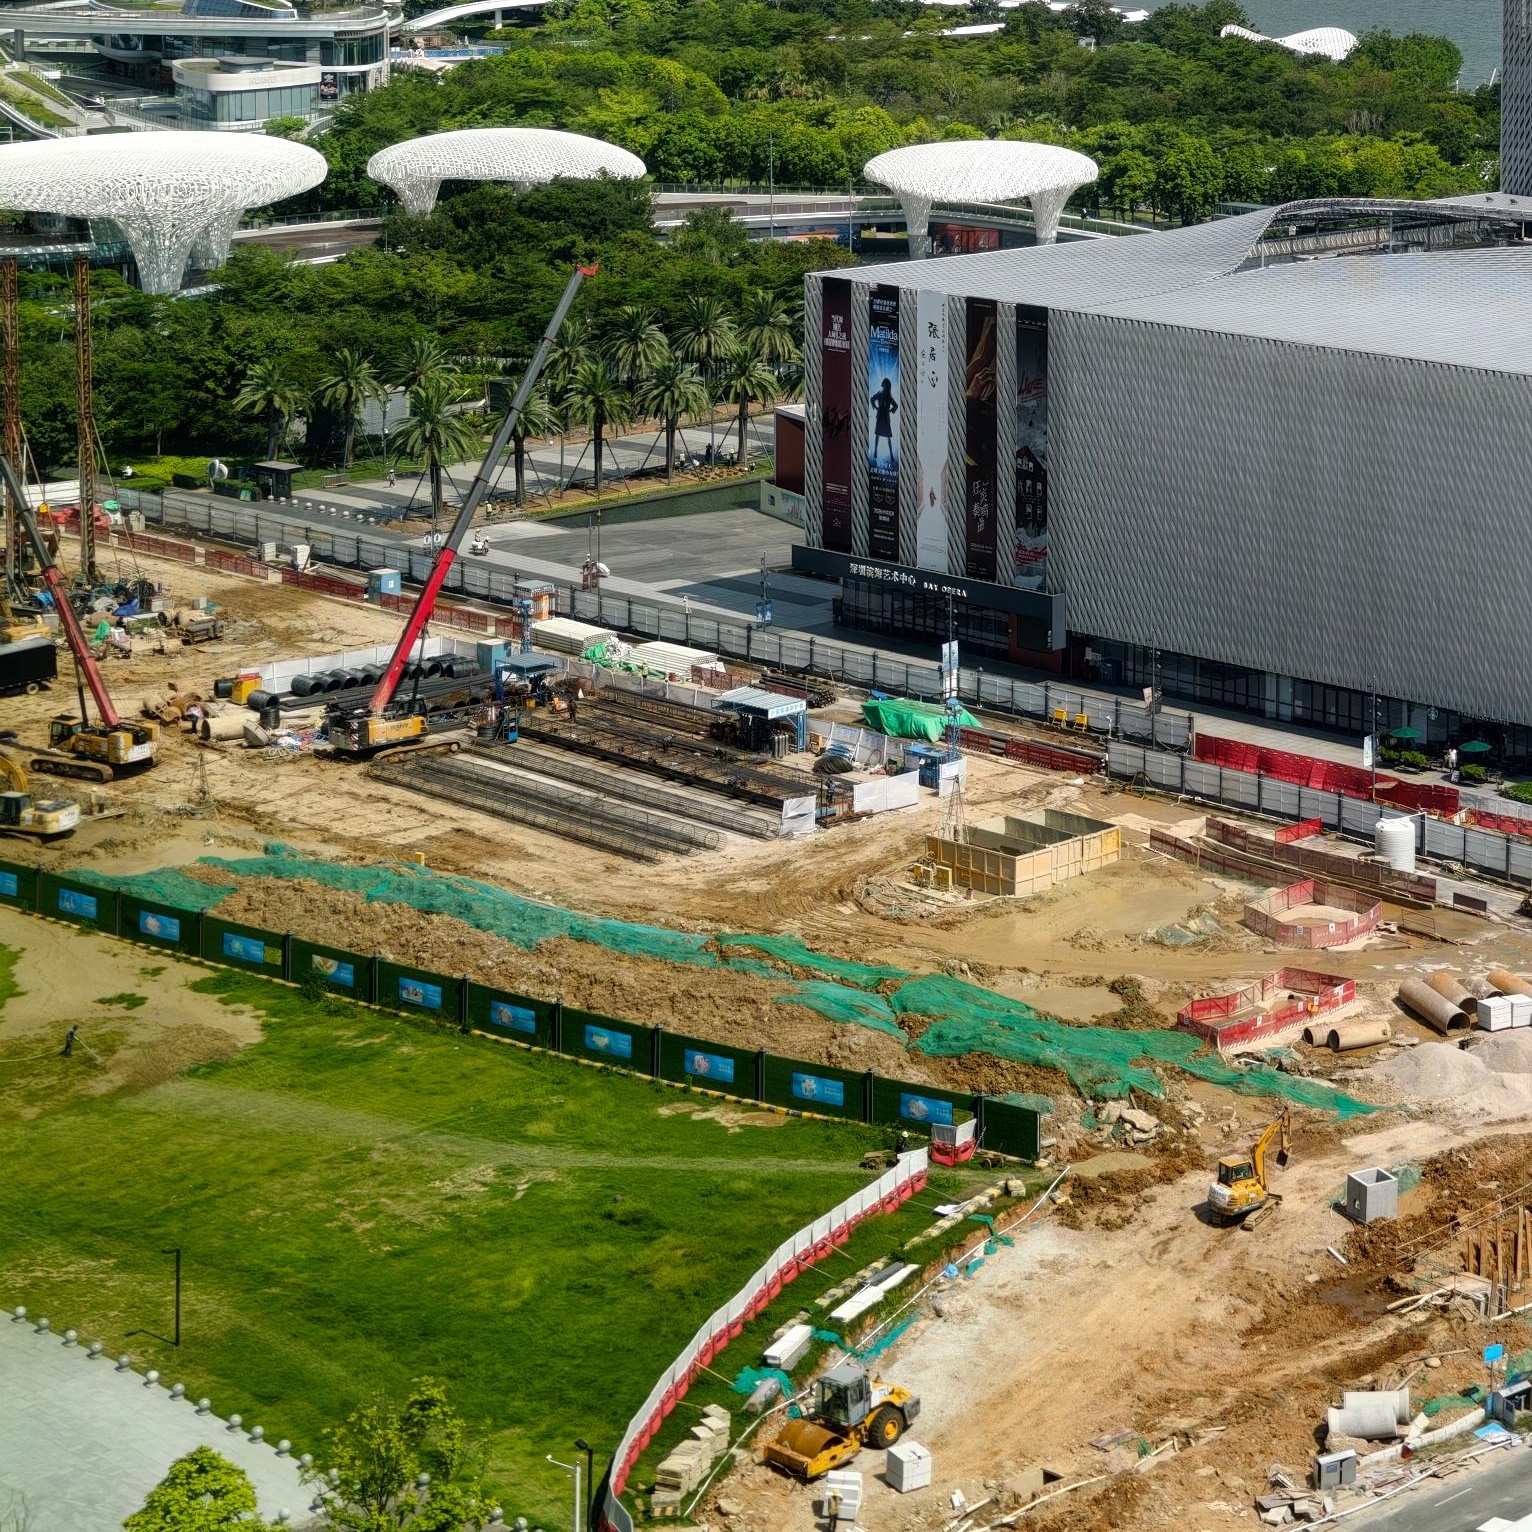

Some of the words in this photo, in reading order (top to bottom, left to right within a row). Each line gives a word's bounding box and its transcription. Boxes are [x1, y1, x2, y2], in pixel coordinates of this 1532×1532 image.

[870, 325, 898, 341] Matilda
[849, 563, 916, 586] 深圳滨海艺术中心
[923, 581, 939, 592] BAY
[941, 585, 968, 598] OPERA
